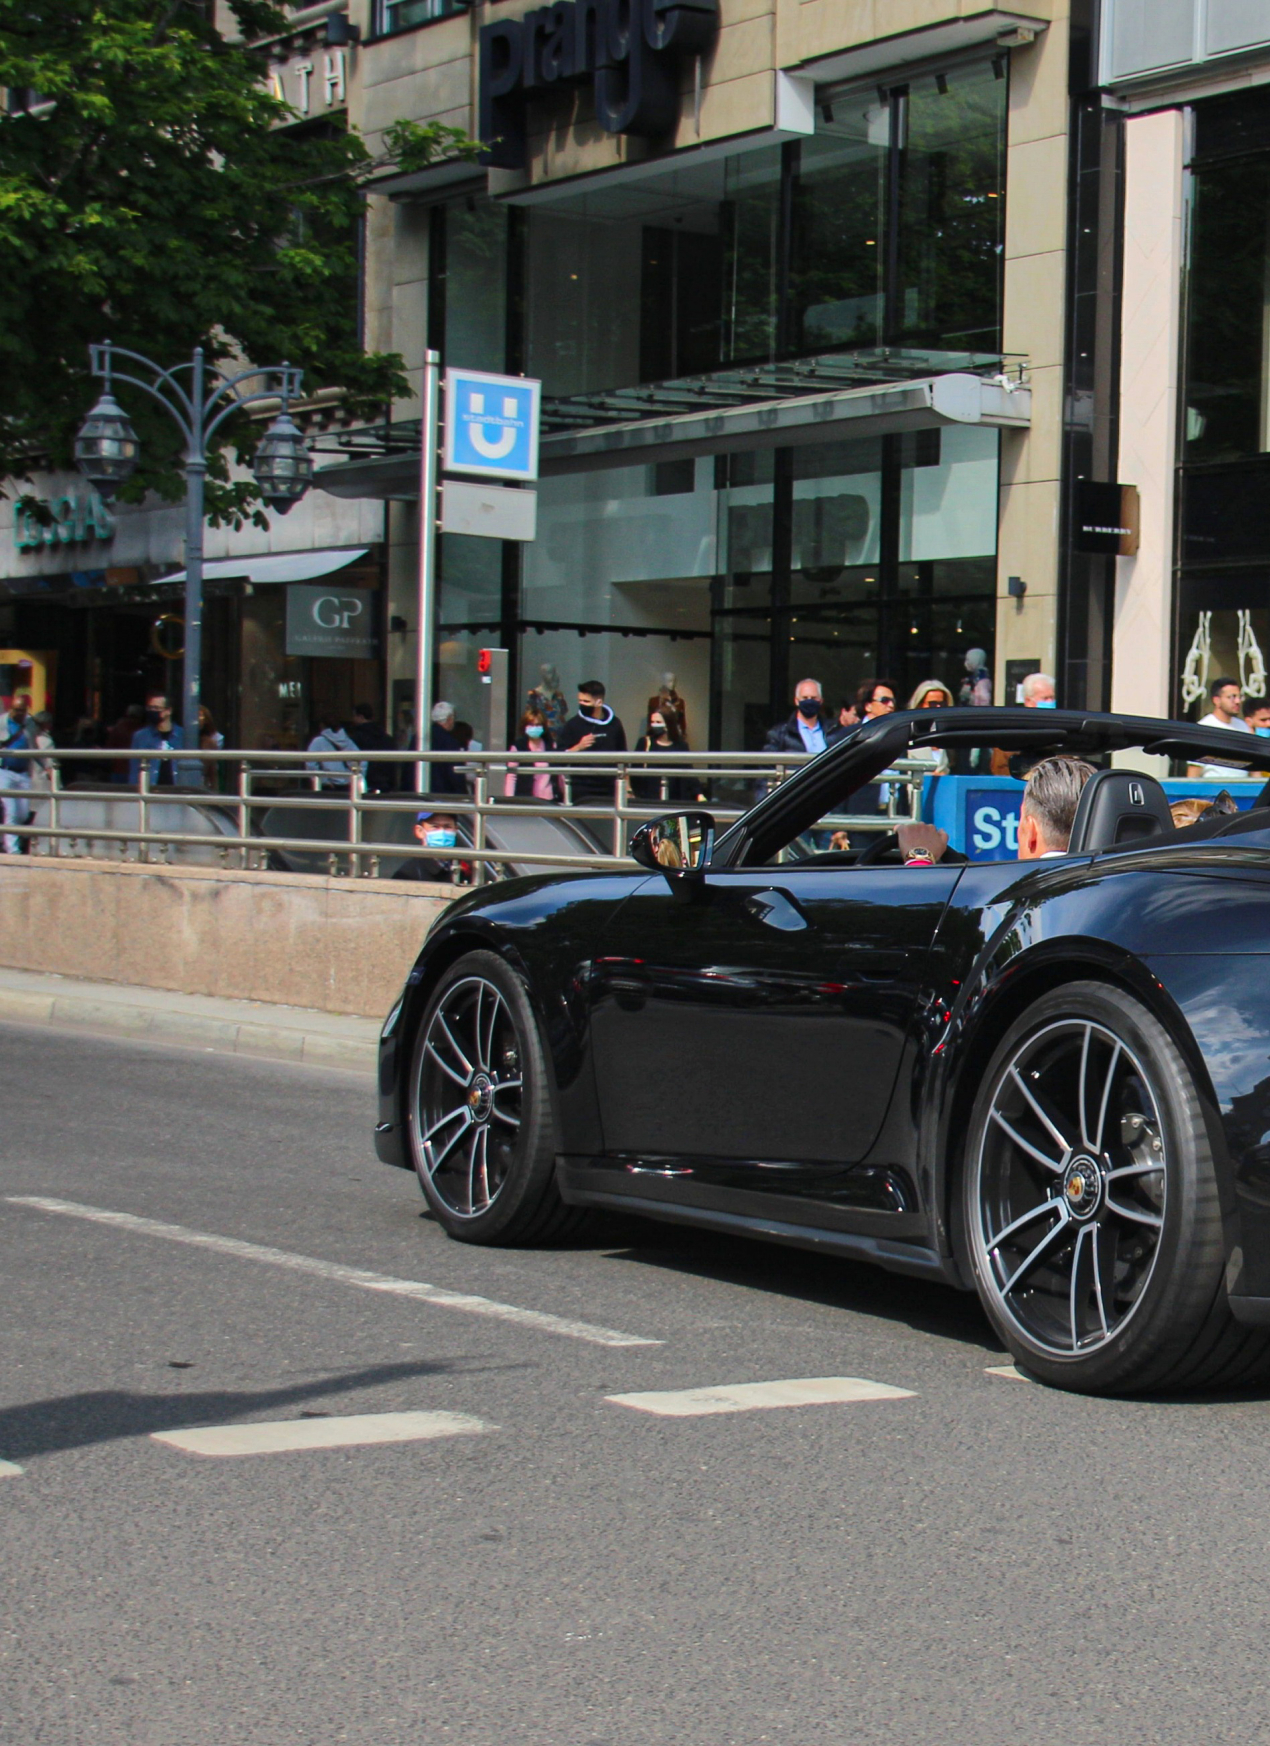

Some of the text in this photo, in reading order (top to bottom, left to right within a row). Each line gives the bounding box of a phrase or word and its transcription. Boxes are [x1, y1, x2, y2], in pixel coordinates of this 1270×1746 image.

[461, 413, 525, 428] stadtbahn
[1082, 525, 1132, 535] BURBERRY
[313, 597, 362, 628] GP
